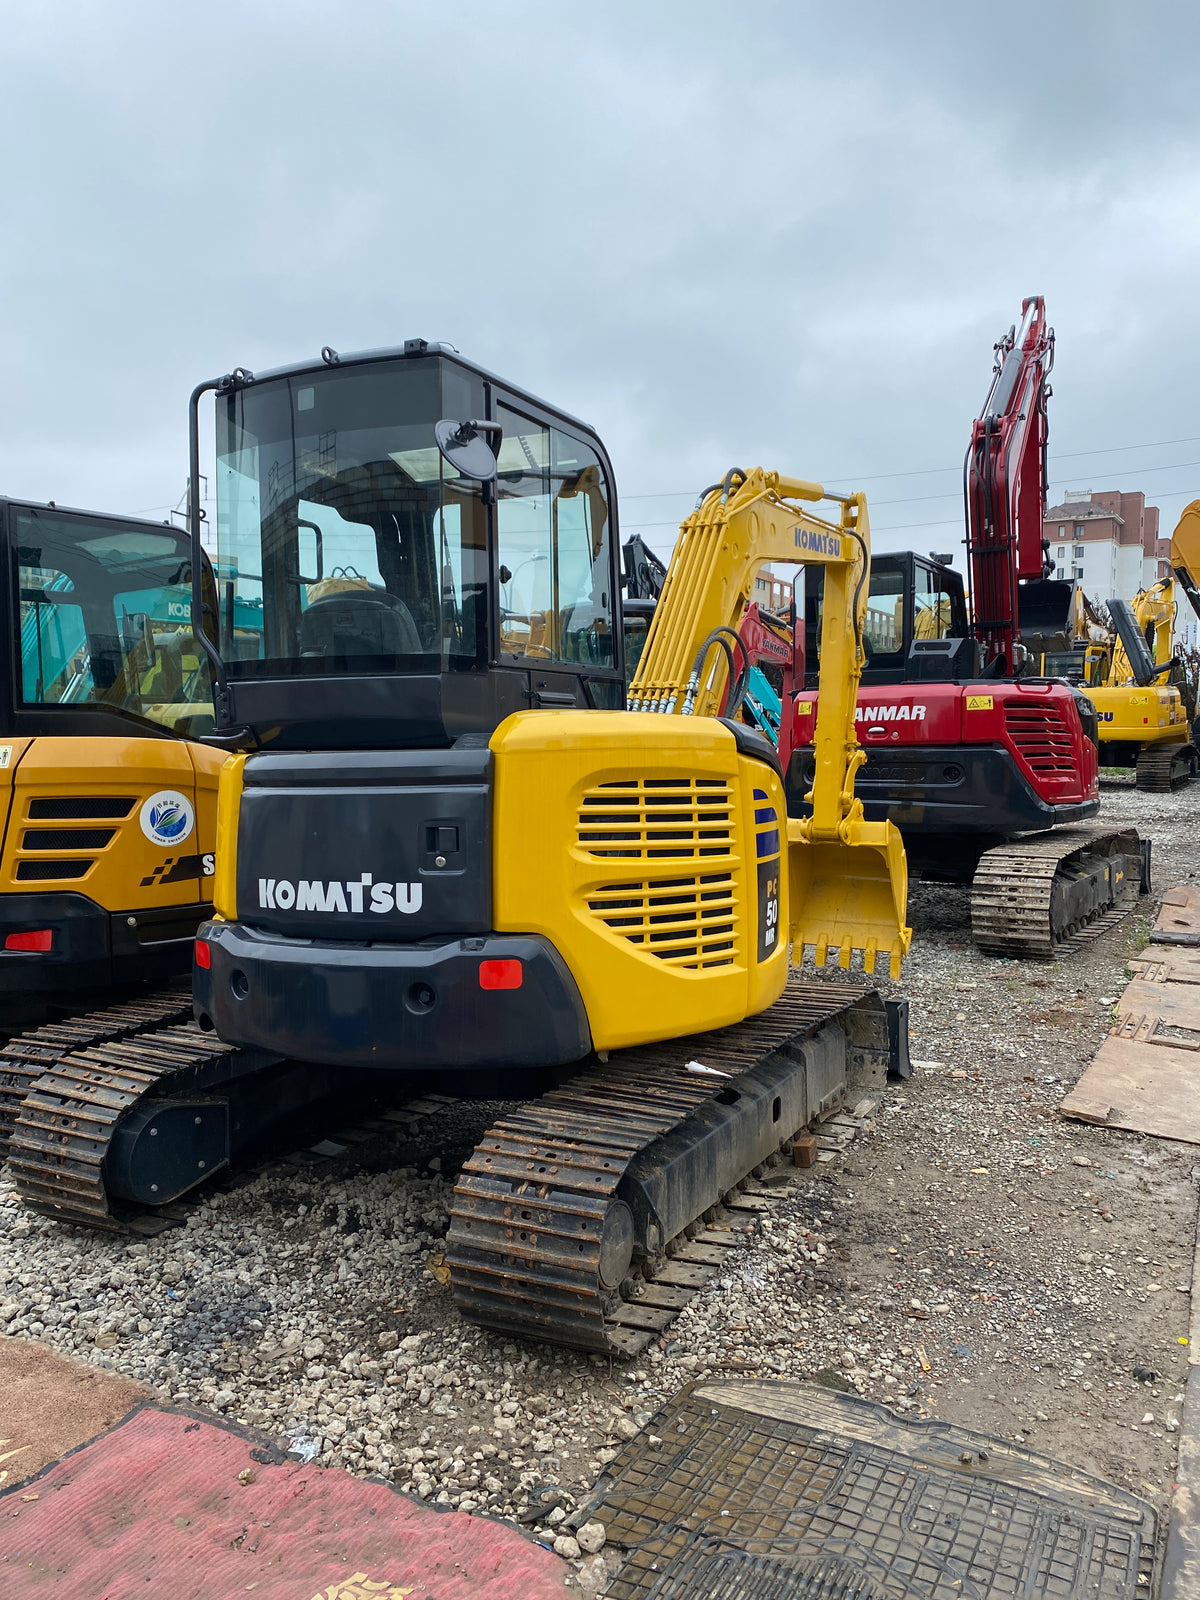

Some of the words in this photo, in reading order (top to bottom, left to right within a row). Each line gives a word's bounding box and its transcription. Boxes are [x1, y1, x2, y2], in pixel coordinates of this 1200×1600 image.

[794, 527, 840, 557] KOMATSU
[168, 602, 192, 617] KOB
[762, 638, 789, 659] YANMAR
[202, 854, 216, 875] S
[258, 872, 423, 914] KOMATSU
[767, 878, 777, 898] PC
[766, 899, 778, 926] 50
[765, 927, 775, 946] MR
